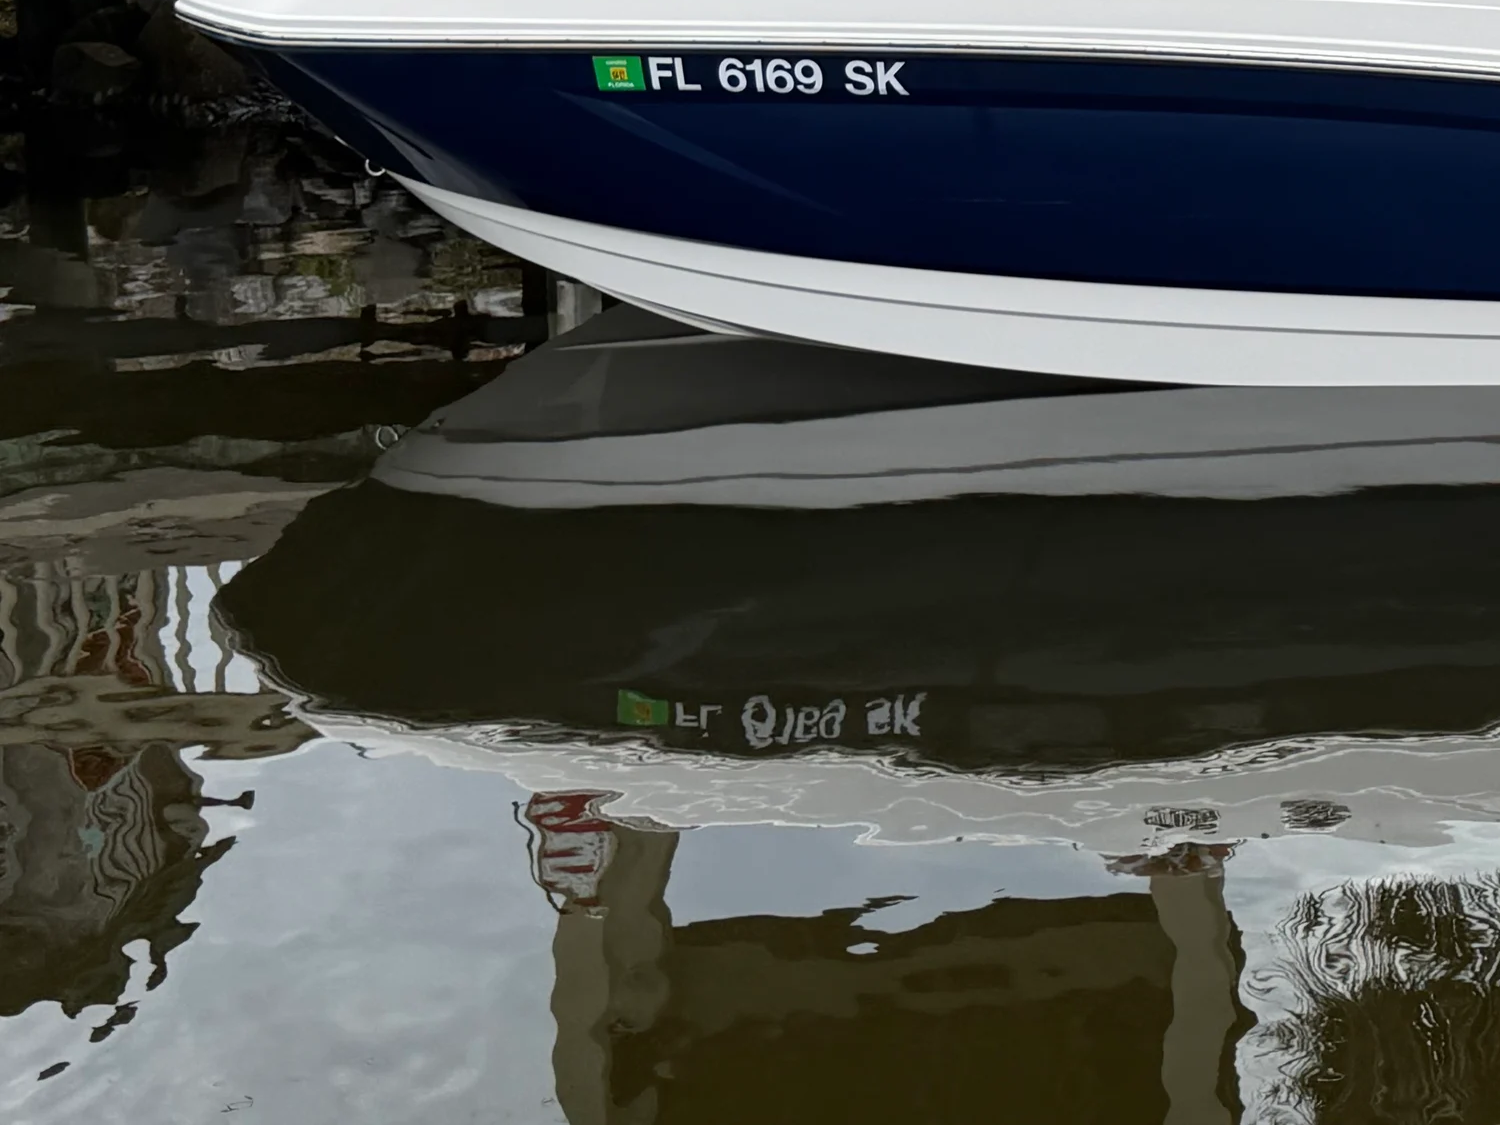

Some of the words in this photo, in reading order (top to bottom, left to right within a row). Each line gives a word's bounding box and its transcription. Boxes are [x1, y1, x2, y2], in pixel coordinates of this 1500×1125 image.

[647, 56, 702, 91] FL
[718, 57, 824, 95] 6169
[844, 59, 911, 96] SK
